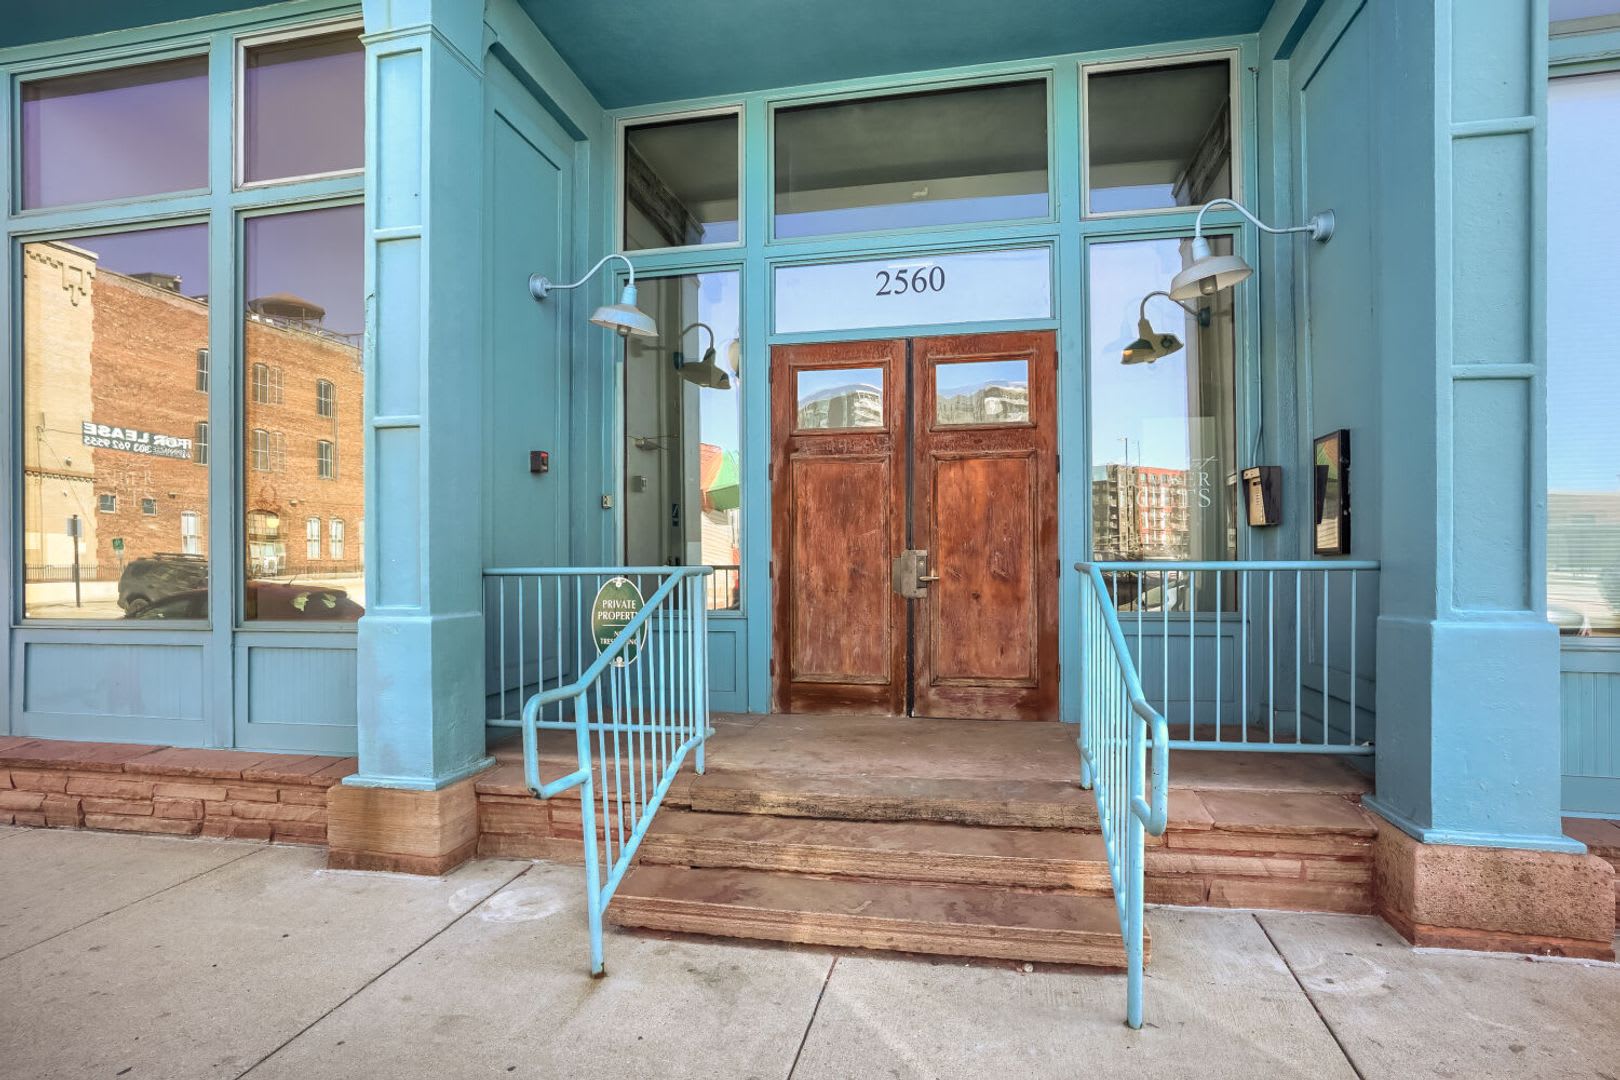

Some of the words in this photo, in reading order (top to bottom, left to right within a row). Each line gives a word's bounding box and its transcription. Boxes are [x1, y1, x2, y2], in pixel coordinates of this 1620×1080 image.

[875, 266, 945, 296] 2560
[602, 600, 636, 609] PRIVATE
[597, 611, 638, 620] PROPERT
